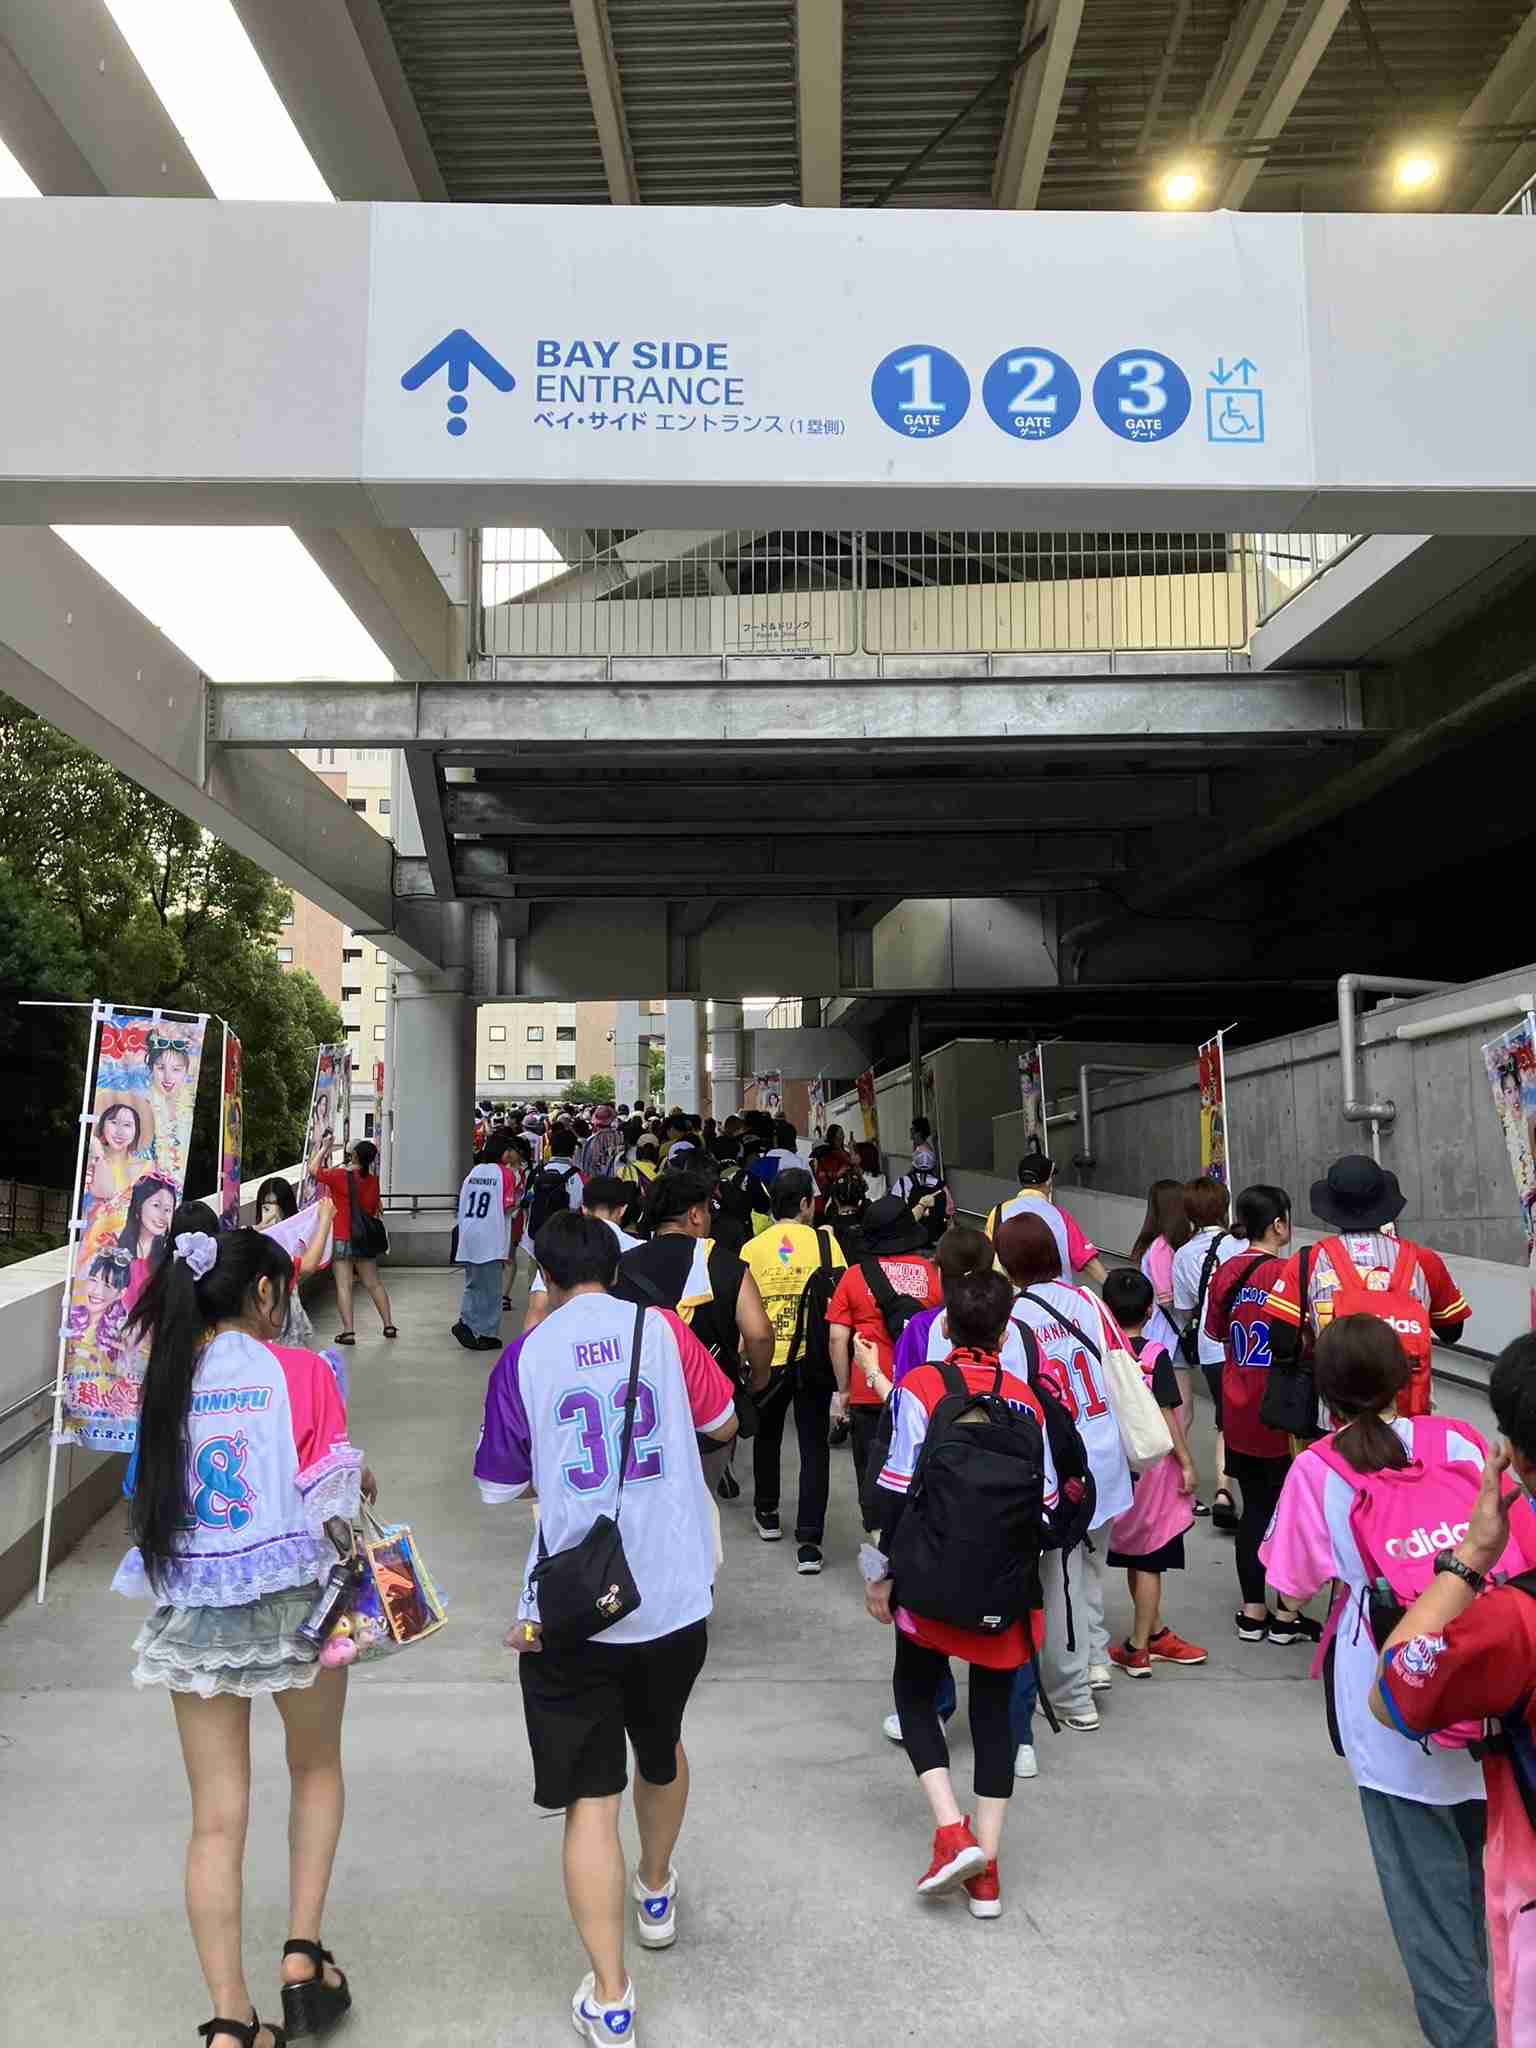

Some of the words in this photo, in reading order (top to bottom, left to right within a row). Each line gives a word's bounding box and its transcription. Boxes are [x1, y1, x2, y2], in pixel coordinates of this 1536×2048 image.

[537, 340, 620, 369] BAY
[632, 341, 728, 371] SIDE
[536, 374, 745, 406] ENTRANCE
[895, 353, 946, 411] 1
[1006, 356, 1058, 414] 2
[1117, 358, 1168, 416] 3
[534, 411, 648, 432] ベイ・サイド
[655, 414, 784, 433] エントランス
[903, 414, 941, 426] GATE
[908, 425, 936, 435] ゲート
[1014, 416, 1051, 428] GATE
[1019, 427, 1047, 438] ゲート
[1125, 418, 1162, 431] GATE
[1130, 430, 1158, 440] ゲート
[465, 1191, 501, 1218] 18
[1035, 1319, 1081, 1343] KANAO
[1230, 1320, 1273, 1367] 02
[575, 1338, 621, 1368] RENI
[192, 1388, 272, 1415] ONOFU
[554, 1376, 665, 1496] 32
[184, 1435, 254, 1531] 8
[1385, 1521, 1470, 1558] adida
